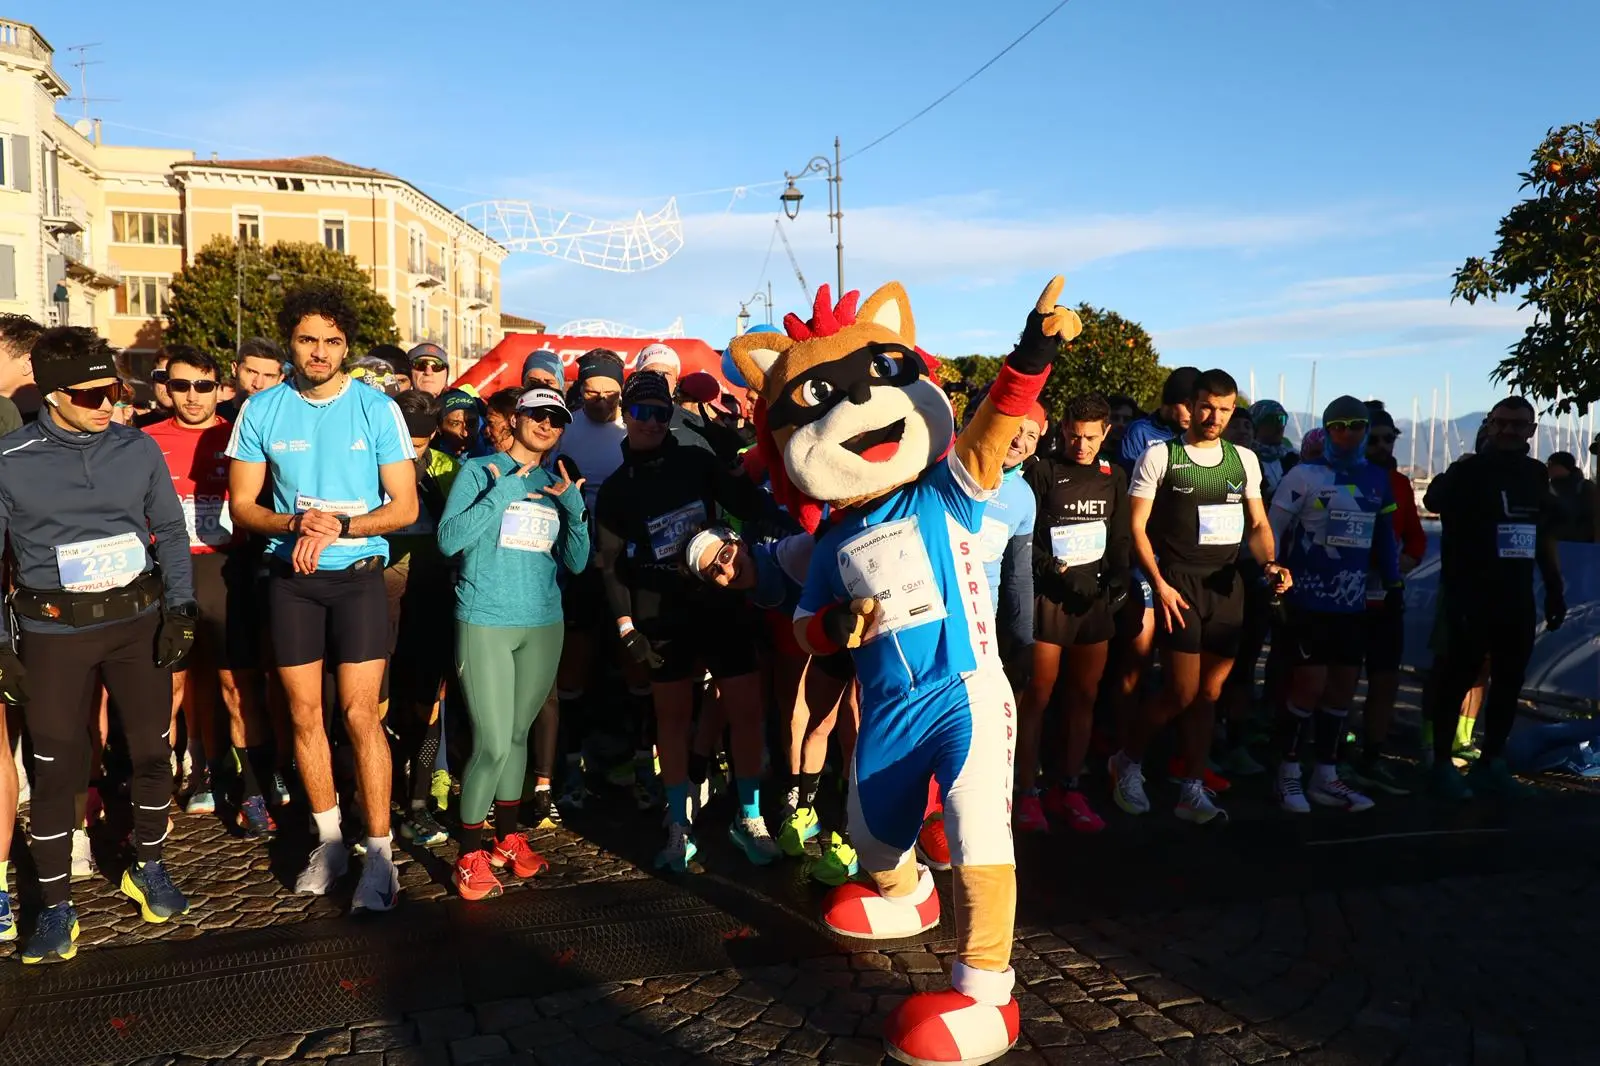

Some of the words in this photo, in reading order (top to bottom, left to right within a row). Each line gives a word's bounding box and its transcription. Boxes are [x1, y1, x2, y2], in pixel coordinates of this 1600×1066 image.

[1077, 500, 1106, 515] MET
[519, 516, 550, 535] 283
[1346, 521, 1364, 535] 35
[850, 529, 903, 556] STRAGARDALAKE
[80, 551, 128, 577] 223
[960, 541, 988, 655] SPRINT
